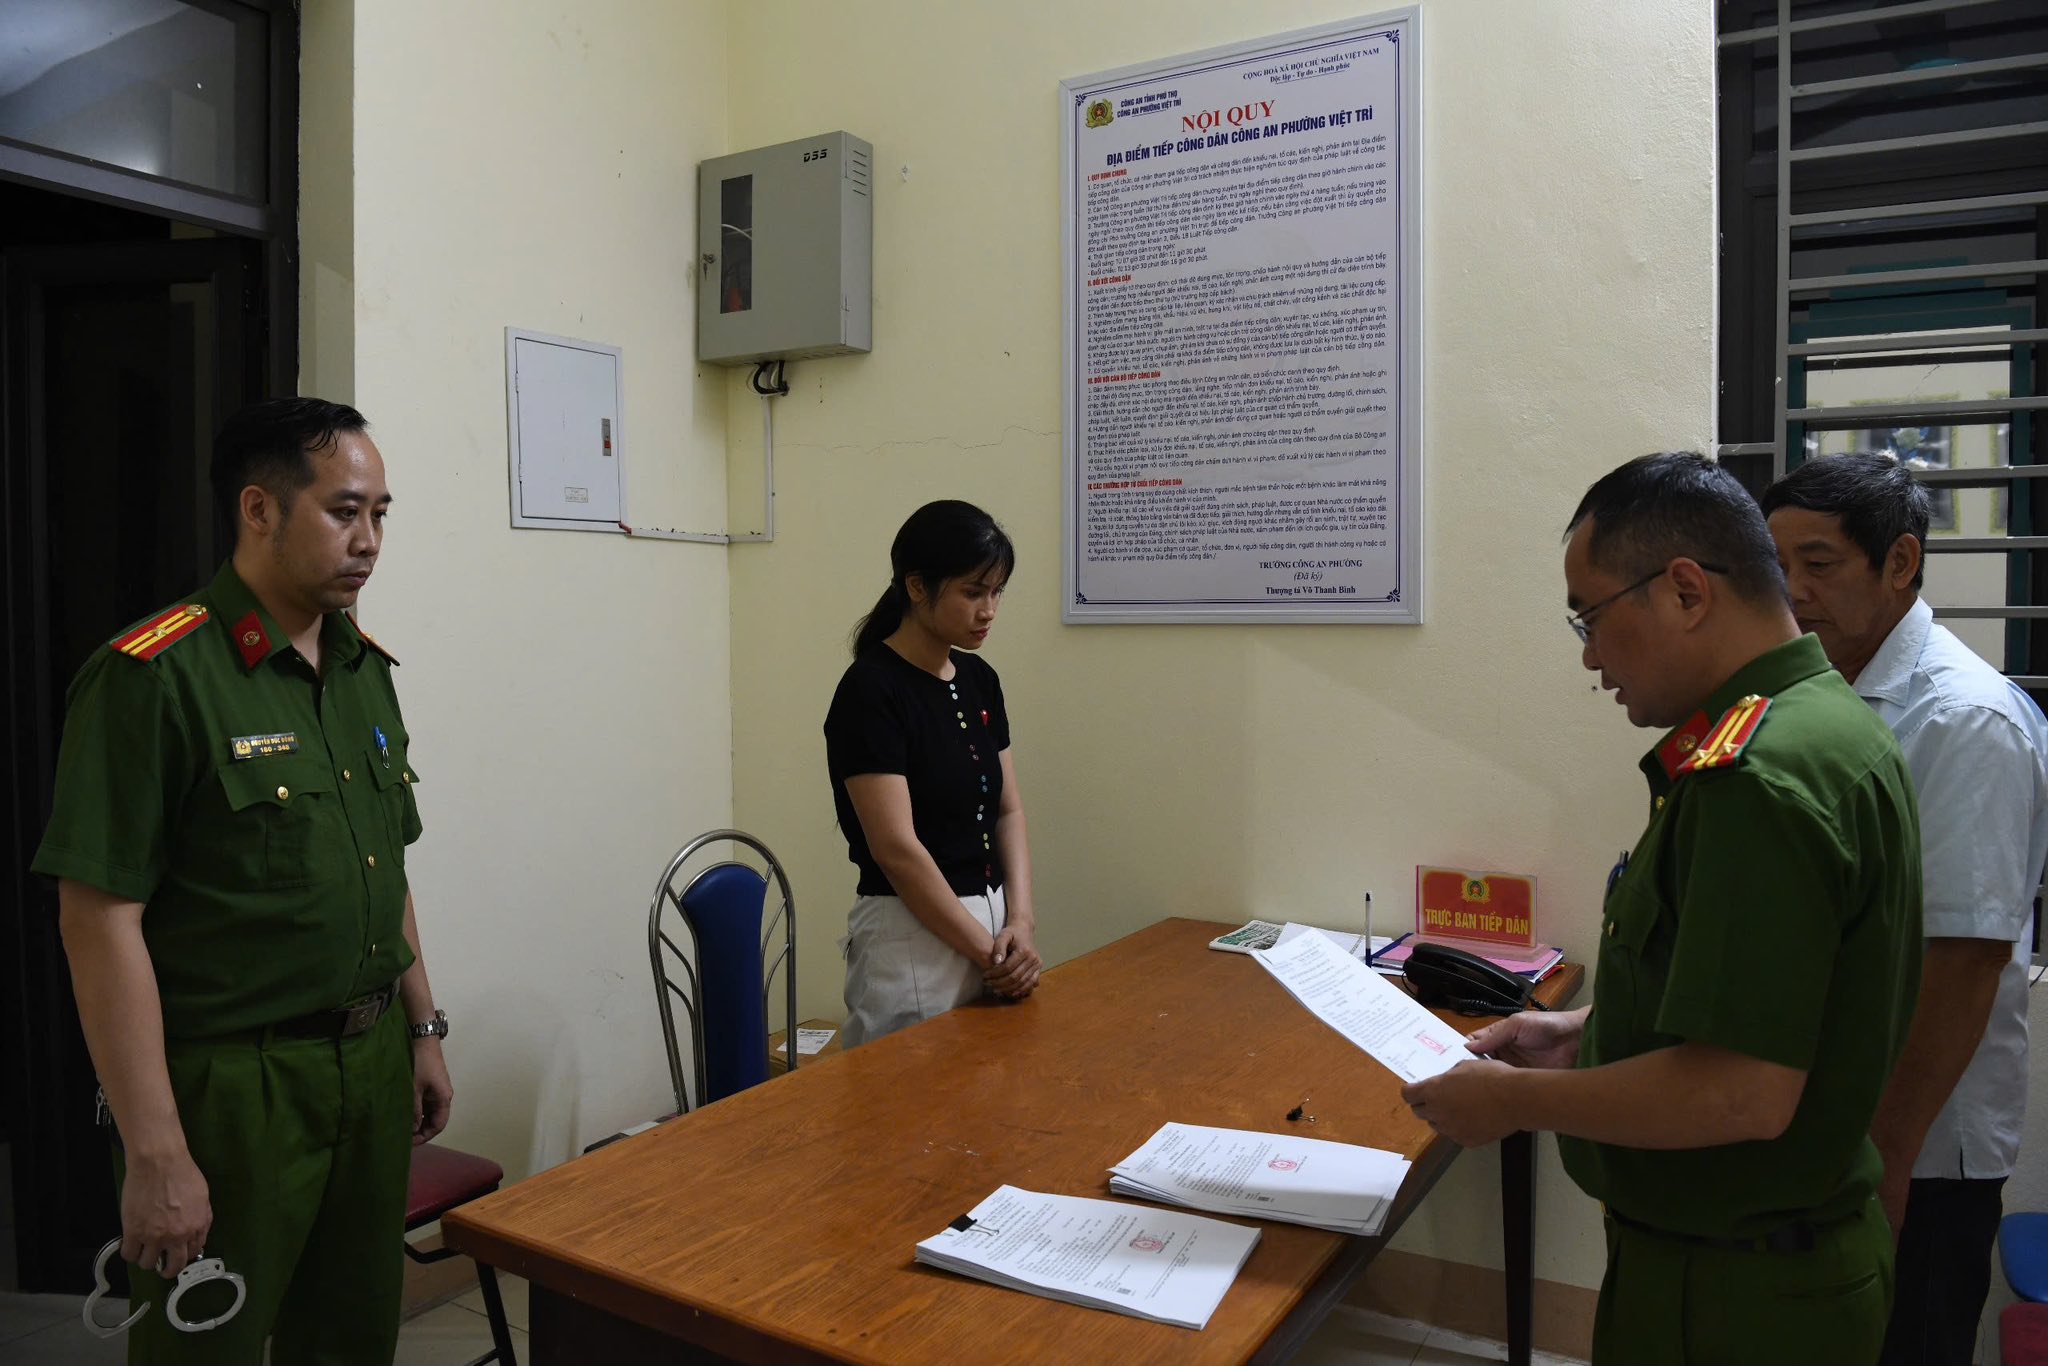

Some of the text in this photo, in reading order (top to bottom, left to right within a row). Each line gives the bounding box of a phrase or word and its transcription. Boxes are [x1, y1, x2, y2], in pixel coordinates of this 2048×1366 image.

[1280, 64, 1289, 72] XÃ
[1290, 62, 1303, 71] HỘI
[1305, 58, 1319, 68] CHỦ
[1321, 53, 1343, 64] NGHĨA
[1344, 50, 1361, 60] VIỆT
[1362, 47, 1380, 56] NAM
[1270, 75, 1281, 83] Độc
[1282, 72, 1291, 81] lập
[1318, 65, 1334, 74] Hạnh
[1335, 62, 1350, 71] phúc
[1117, 108, 1130, 118] CÔNG
[1140, 102, 1160, 113] PHƯỜNG
[1161, 100, 1172, 110] VIỆT
[1173, 98, 1181, 107] TRÌ
[1120, 98, 1134, 108] CÔNG
[1144, 93, 1156, 103] TỈNH
[1156, 91, 1167, 100] PHÚ
[1168, 90, 1178, 99] THỌ
[1182, 100, 1276, 133] NỘI QUY
[1106, 105, 1373, 167] ĐỊA ĐIỂM TIẾP CÔNG DÂN CÔNG AN PHƯỜNG VIỆT TRÌ
[1259, 560, 1291, 569] TRƯỞNG
[1292, 559, 1315, 568] CÔNG
[1328, 558, 1362, 568] PHƯỜNG
[1293, 571, 1323, 581] (Đã ký)
[1265, 586, 1292, 596] Thượng
[1425, 908, 1528, 935] TRỰC BAN TIẾP DÂN
